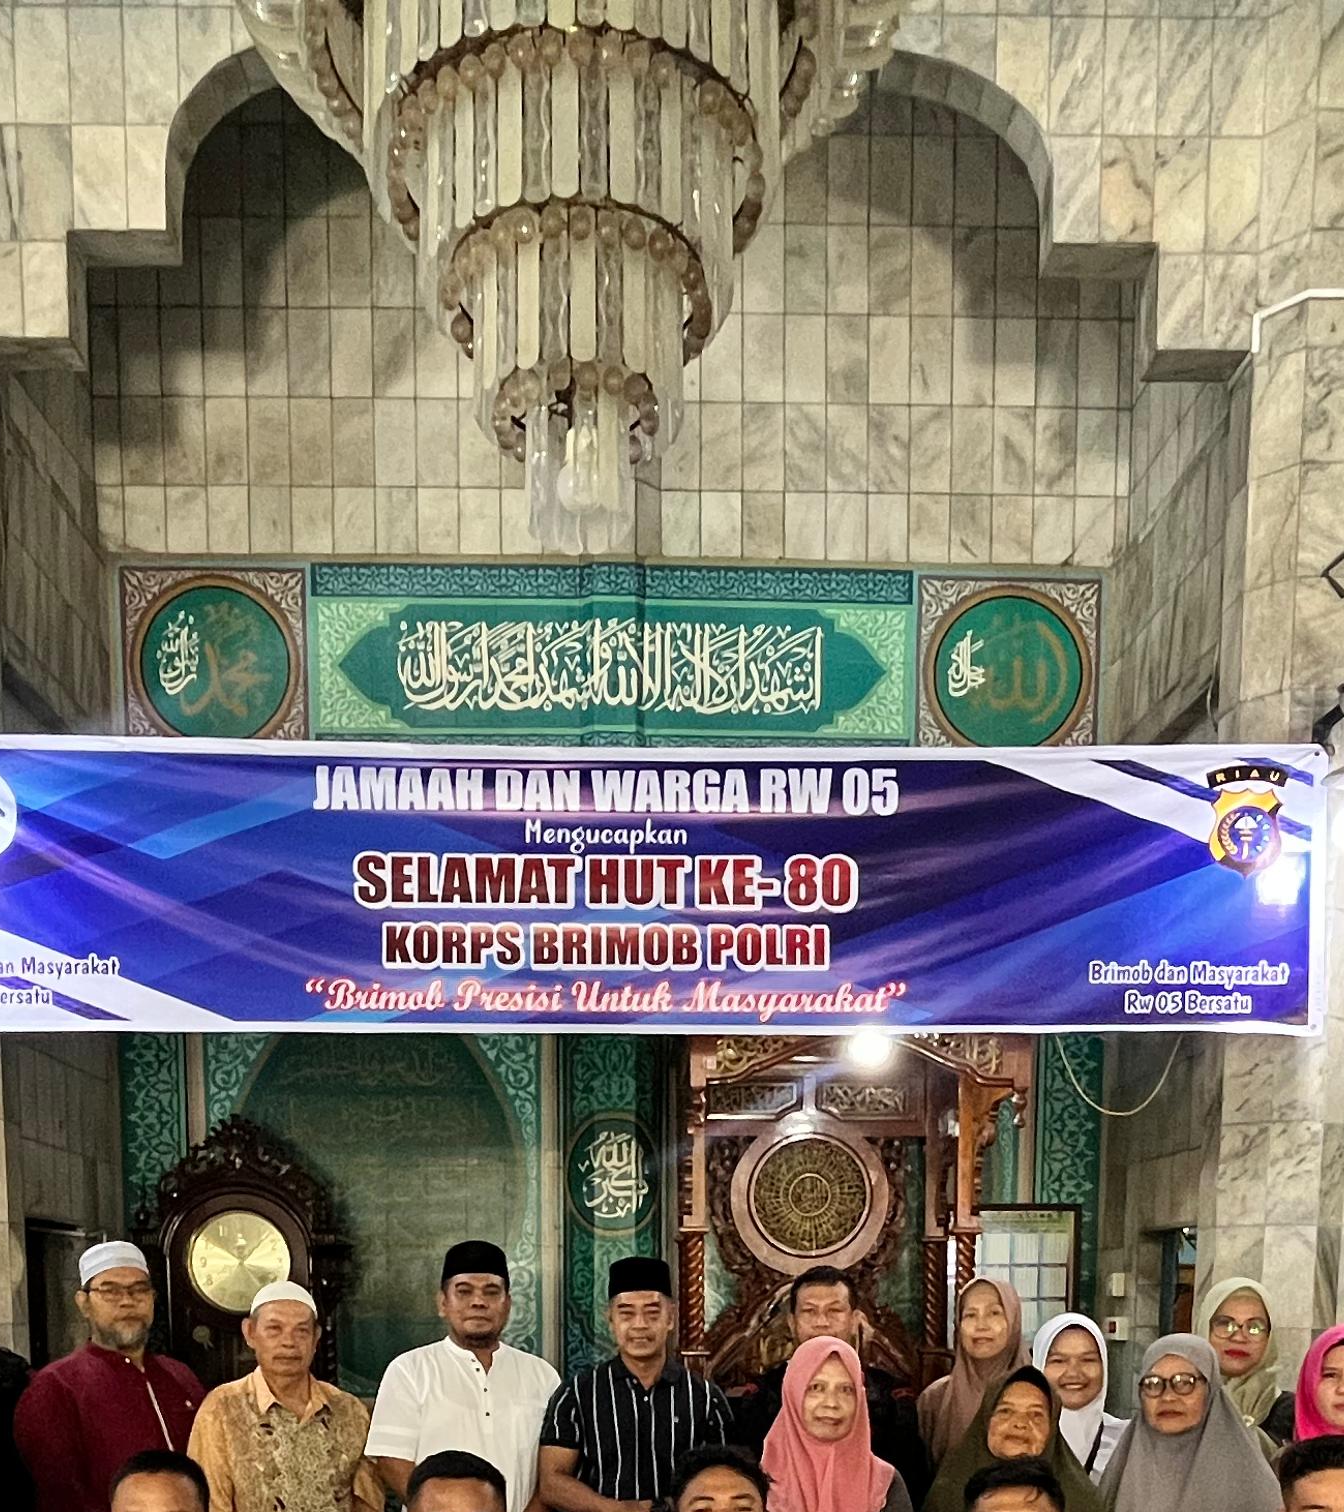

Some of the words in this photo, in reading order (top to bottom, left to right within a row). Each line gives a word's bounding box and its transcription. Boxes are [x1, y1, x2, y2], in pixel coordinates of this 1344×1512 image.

[313, 765, 489, 811] JAMAAH
[496, 768, 582, 812] DAN
[591, 768, 755, 814] WARGA
[759, 767, 836, 814] RW
[843, 767, 899, 816] 05
[1215, 768, 1280, 782] RIAU
[525, 819, 687, 853] Mengucapkan
[354, 850, 579, 907] SELAMAT
[586, 853, 693, 907] HUT
[383, 922, 524, 970] KORPS
[531, 922, 701, 970] BRIMOB
[708, 925, 829, 971] POLRI
[22, 955, 120, 979] Masyarakat
[1090, 962, 1151, 983] Brimob
[1156, 962, 1186, 983] dan
[1192, 962, 1289, 989] Masyarakat
[455, 980, 562, 1014] Presisi
[571, 979, 672, 1014] Untuk
[1126, 992, 1154, 1013] Rw
[1158, 993, 1181, 1013] 05
[1187, 992, 1251, 1013] Bersatu
